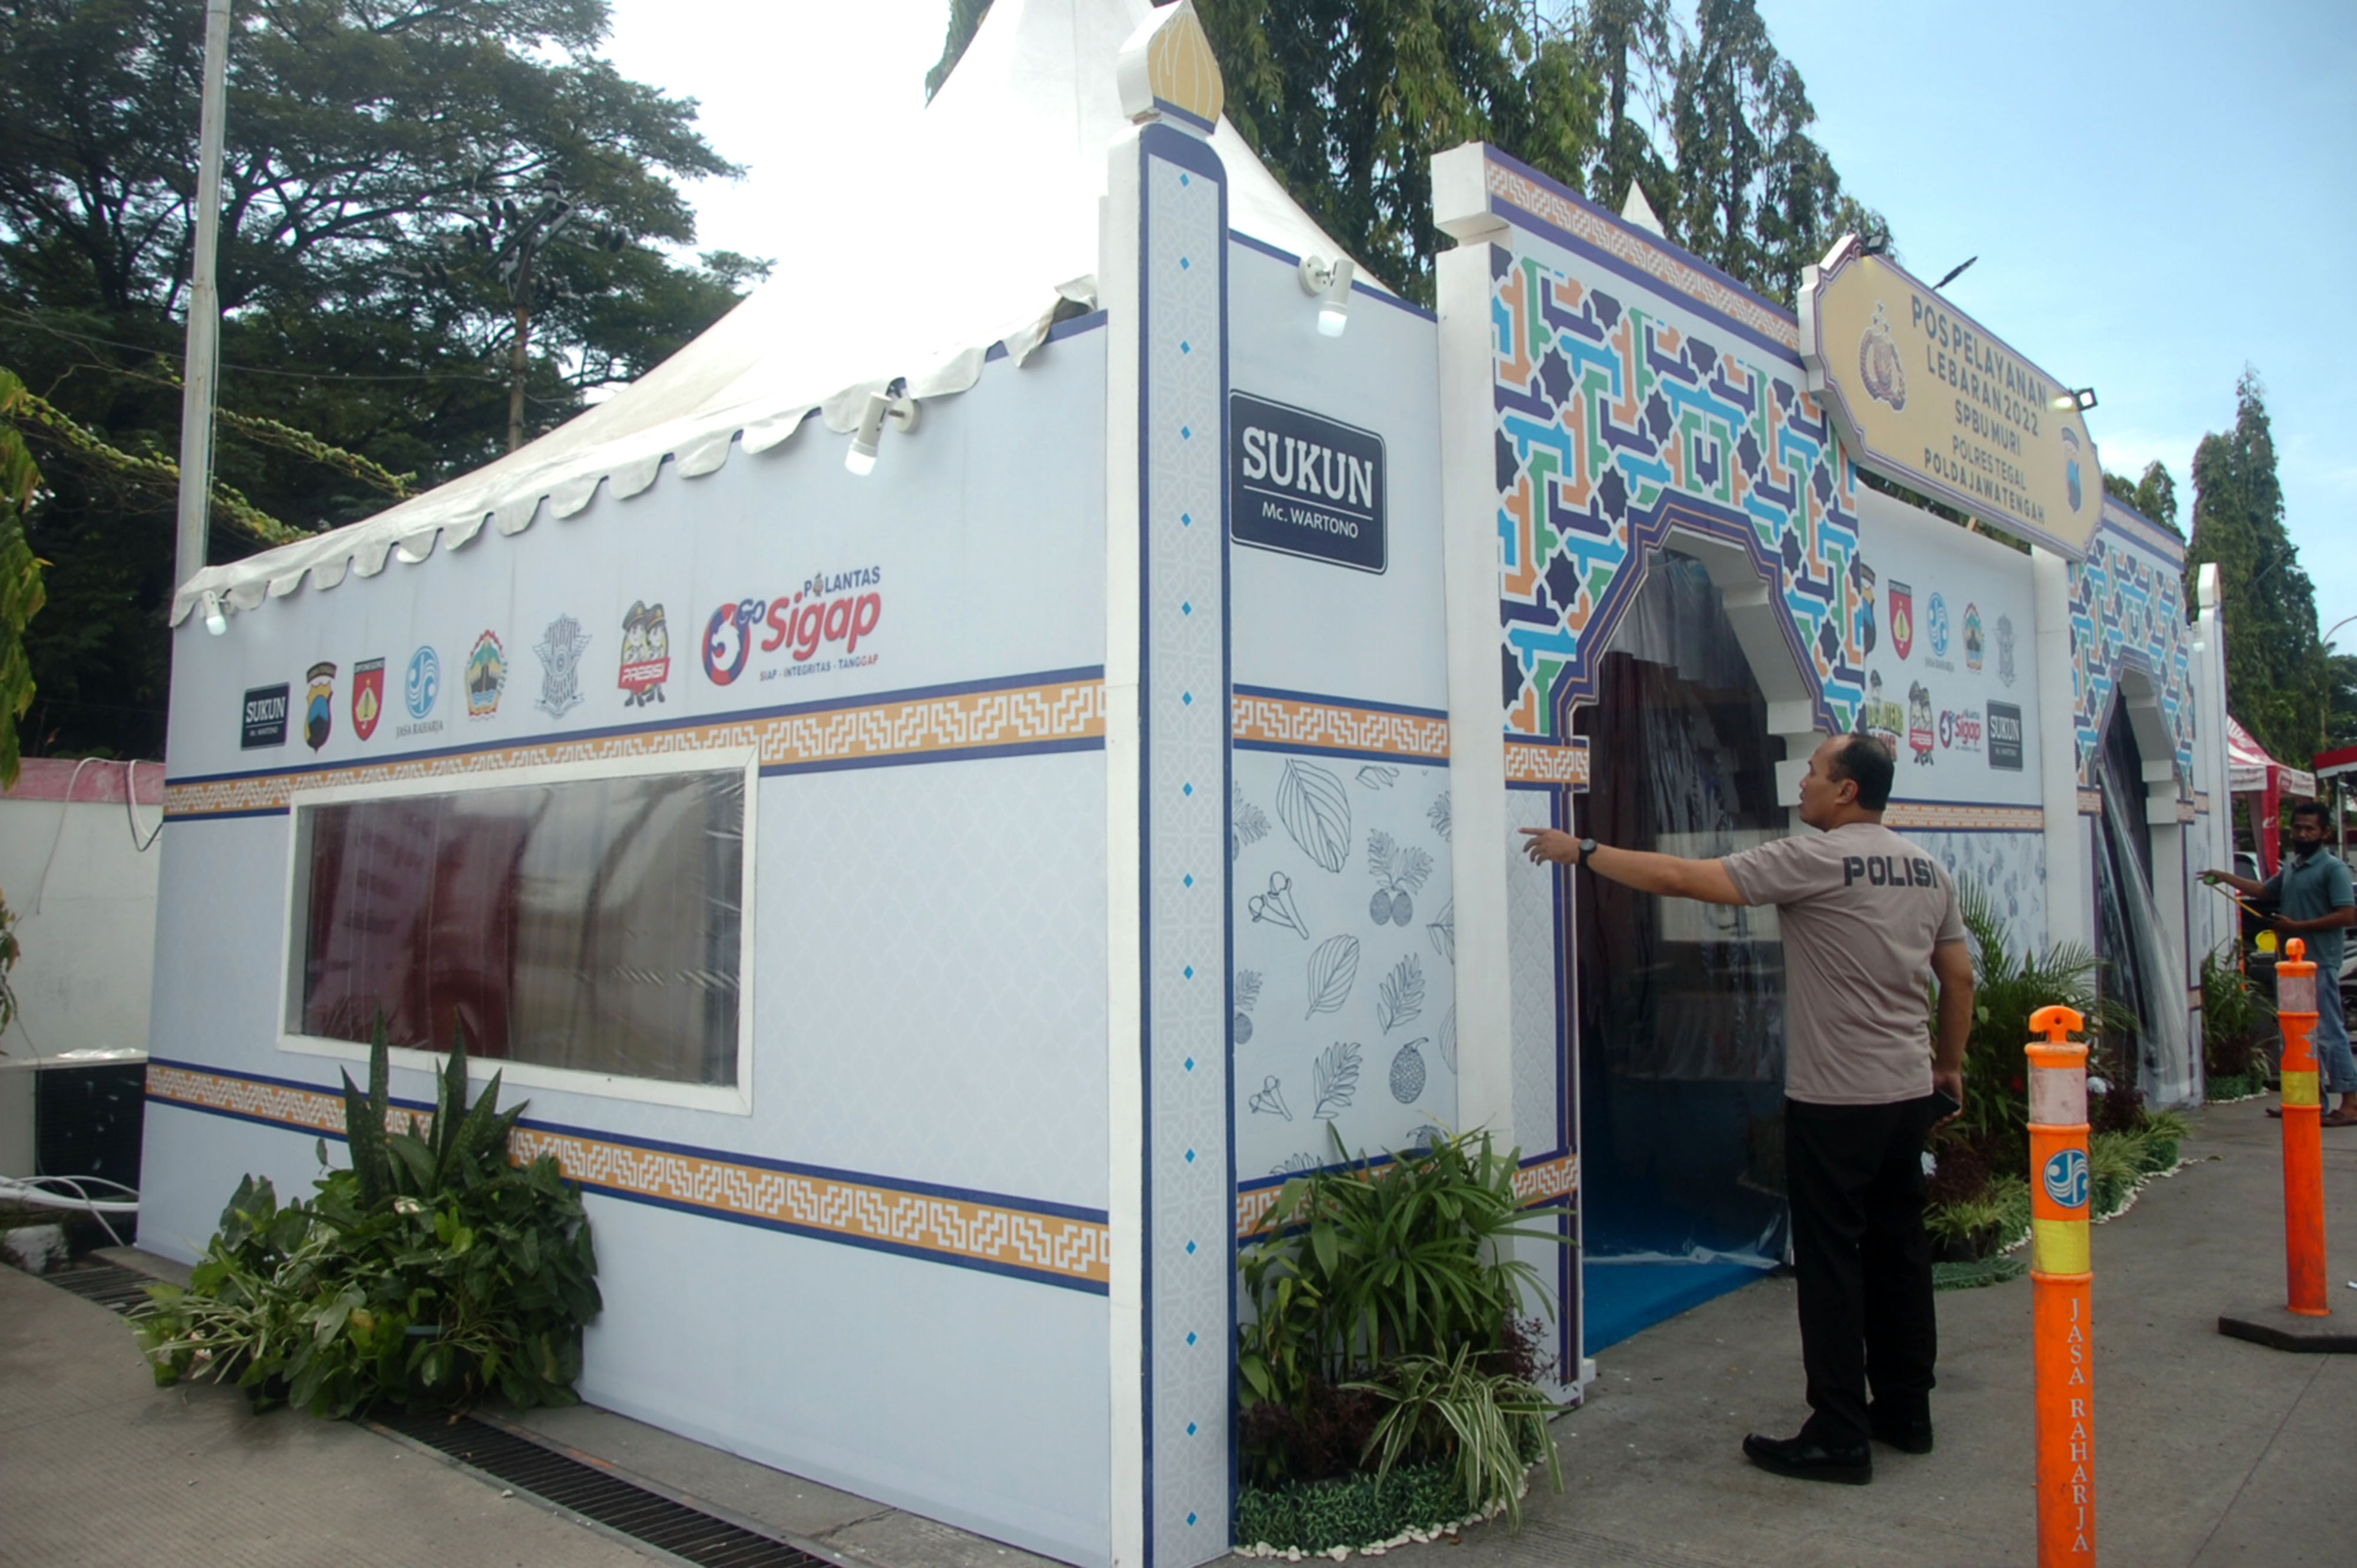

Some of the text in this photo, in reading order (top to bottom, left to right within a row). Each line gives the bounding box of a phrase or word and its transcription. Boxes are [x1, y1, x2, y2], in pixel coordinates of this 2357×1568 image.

[1912, 295, 2047, 412] POS PELAYANAN
[1927, 344, 2038, 437] LEBARAN 2022
[1955, 399, 1989, 438] SPBU
[1990, 420, 2021, 457] MURI
[1242, 425, 1373, 509] SUKUN
[1924, 448, 2044, 524] POLDA JAWA TENGAH
[1953, 434, 2026, 491] POLRES TEGAL
[1290, 507, 1359, 539] WARTONO
[761, 591, 882, 661] Sigap
[760, 653, 879, 682] SIAP INTEGRITAS TANGGAP
[246, 696, 286, 723] SUKUN
[1990, 715, 2019, 742] SUKUN
[1843, 856, 1937, 889] POLISI
[2066, 1298, 2089, 1553] JASA RAHARJA
